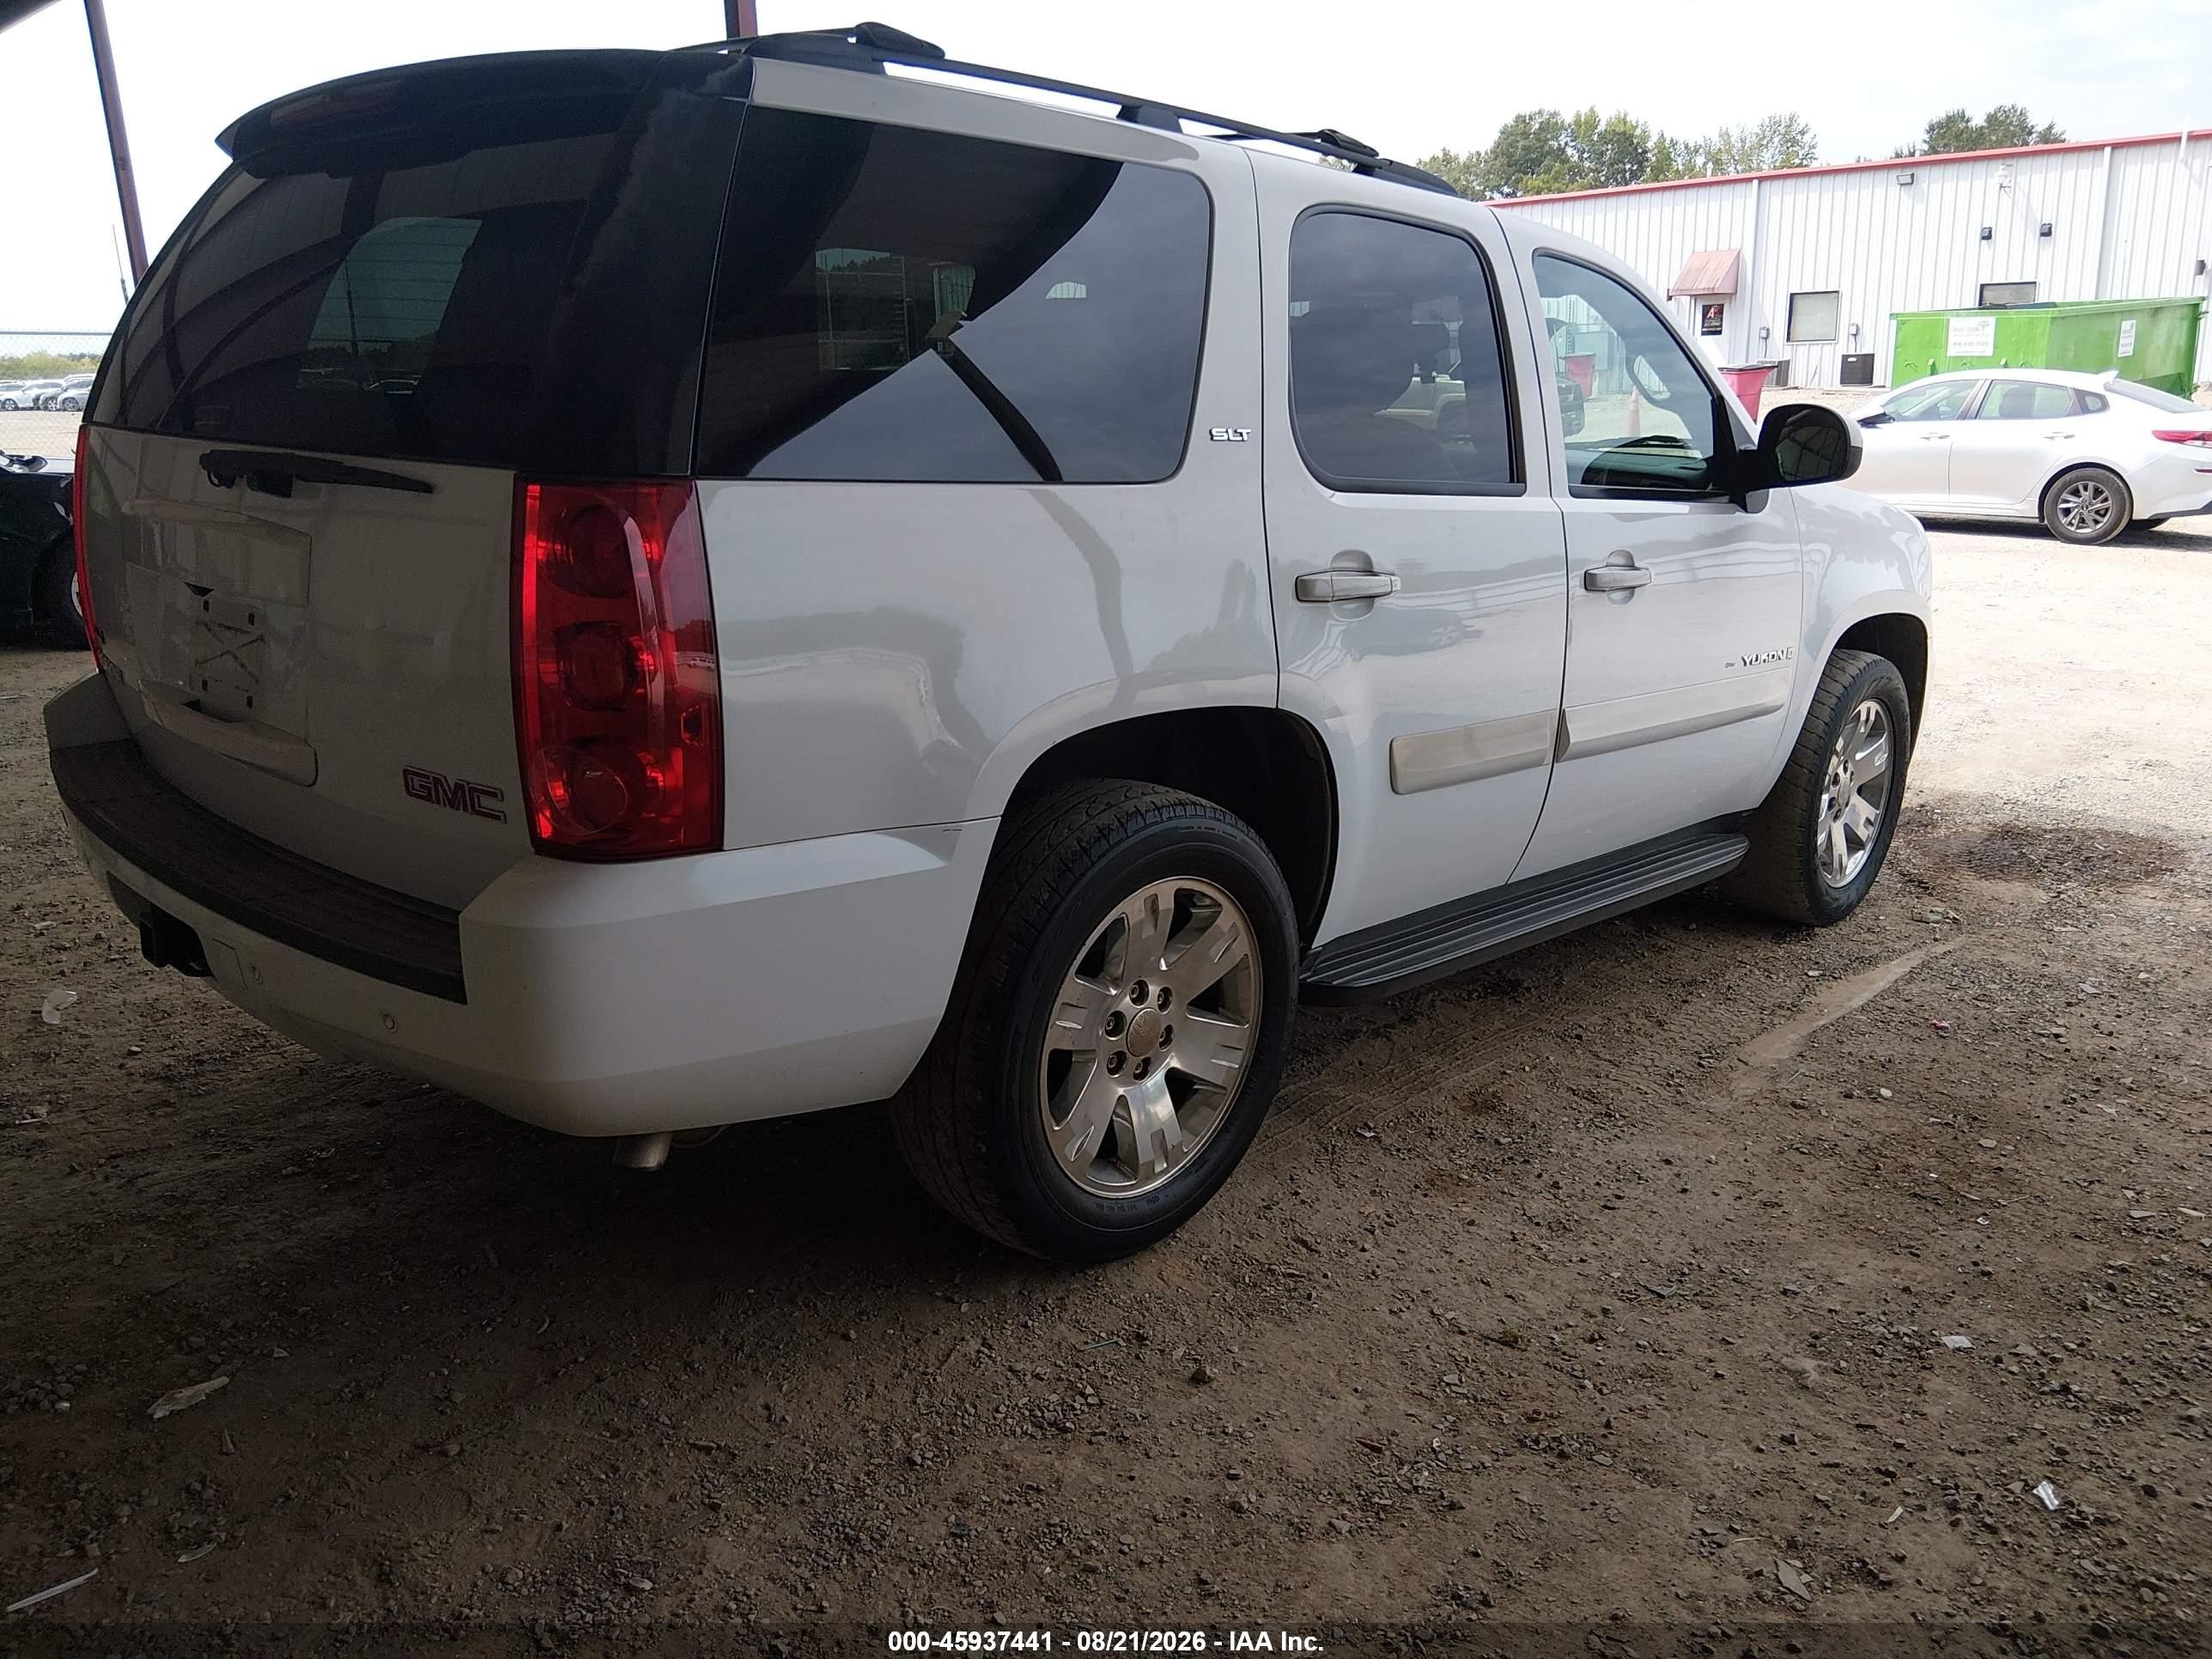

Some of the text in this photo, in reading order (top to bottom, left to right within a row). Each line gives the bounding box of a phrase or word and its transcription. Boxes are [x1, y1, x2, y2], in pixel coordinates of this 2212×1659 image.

[1209, 428, 1251, 441] SLT
[1741, 648, 1786, 667] YUKON
[403, 765, 507, 824] GMC
